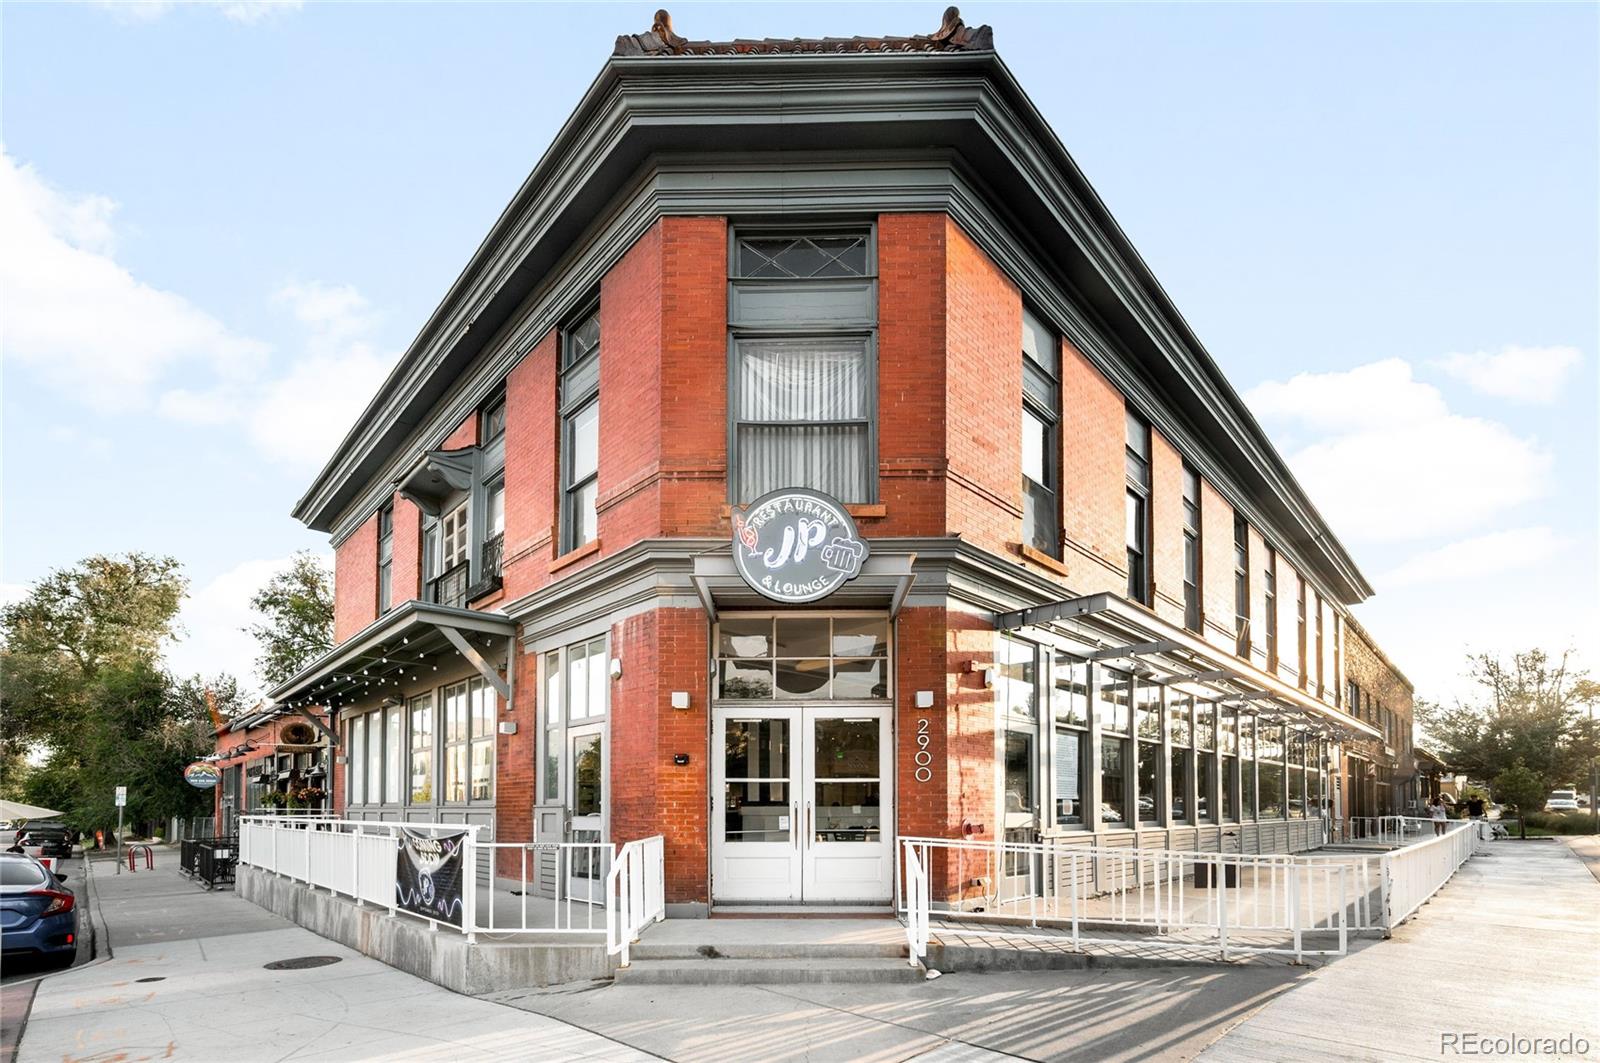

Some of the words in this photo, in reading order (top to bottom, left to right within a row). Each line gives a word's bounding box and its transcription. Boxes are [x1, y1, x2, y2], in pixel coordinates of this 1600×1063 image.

[752, 499, 840, 529] RESTAURANT
[763, 517, 827, 569] JP
[762, 575, 773, 589] &
[774, 575, 830, 595] LOUNGE
[914, 718, 932, 782] 2900
